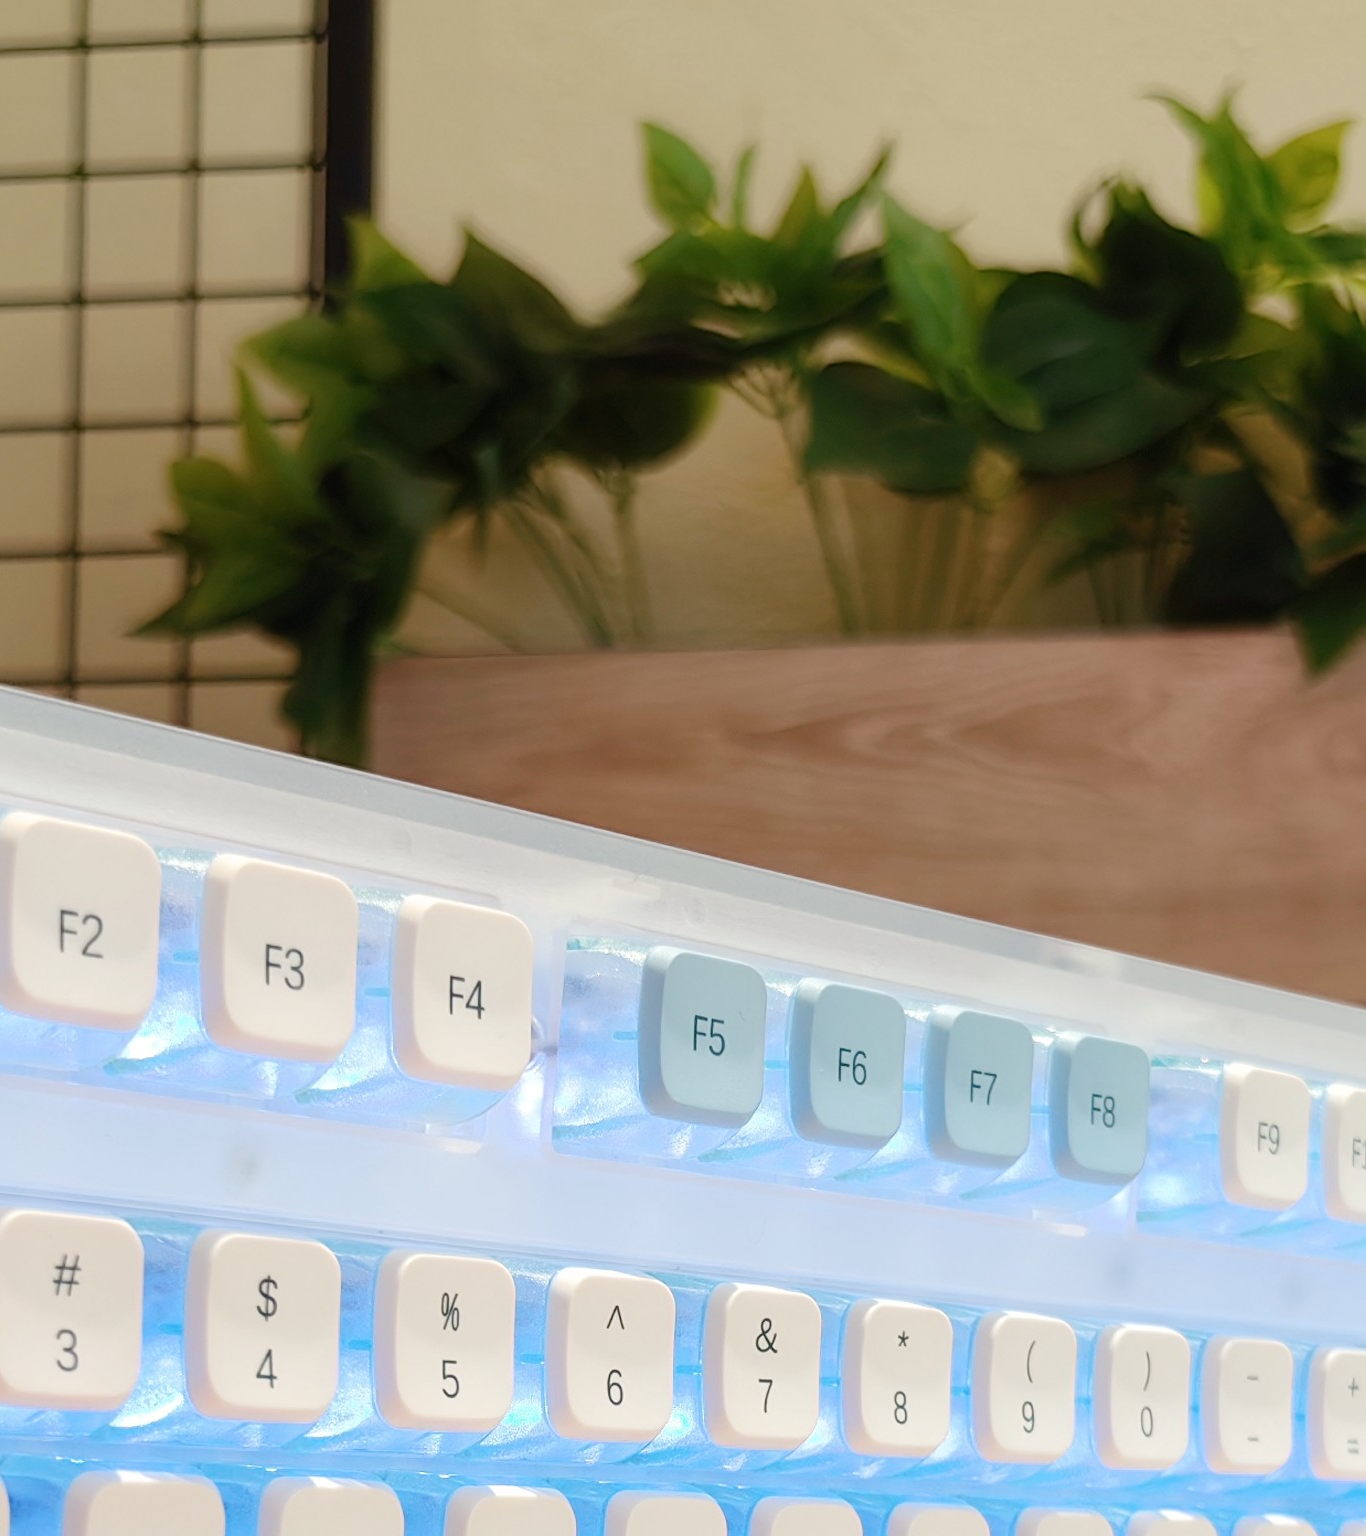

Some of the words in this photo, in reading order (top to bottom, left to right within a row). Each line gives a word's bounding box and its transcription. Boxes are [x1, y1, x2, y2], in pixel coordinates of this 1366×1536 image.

[58, 908, 104, 959] F2
[264, 942, 306, 991] F3
[448, 974, 485, 1020] F4
[692, 1014, 726, 1057] F5
[837, 1046, 868, 1086] F6
[969, 1069, 998, 1106] F7
[1090, 1092, 1116, 1129] F8
[1257, 1121, 1282, 1156] F9
[52, 1255, 81, 1295] #
[256, 1275, 278, 1321] $
[440, 1291, 461, 1332] %
[606, 1304, 625, 1330] ^
[55, 1328, 79, 1373] 3
[755, 1317, 778, 1354] &
[255, 1348, 278, 1388] 4
[441, 1359, 460, 1399] 5
[1025, 1340, 1037, 1384] (
[1142, 1351, 1152, 1392] )
[606, 1368, 624, 1407] 6
[758, 1378, 774, 1414] 7
[893, 1390, 909, 1426] 8
[1021, 1400, 1036, 1435] 9
[1139, 1405, 1155, 1439] 0
